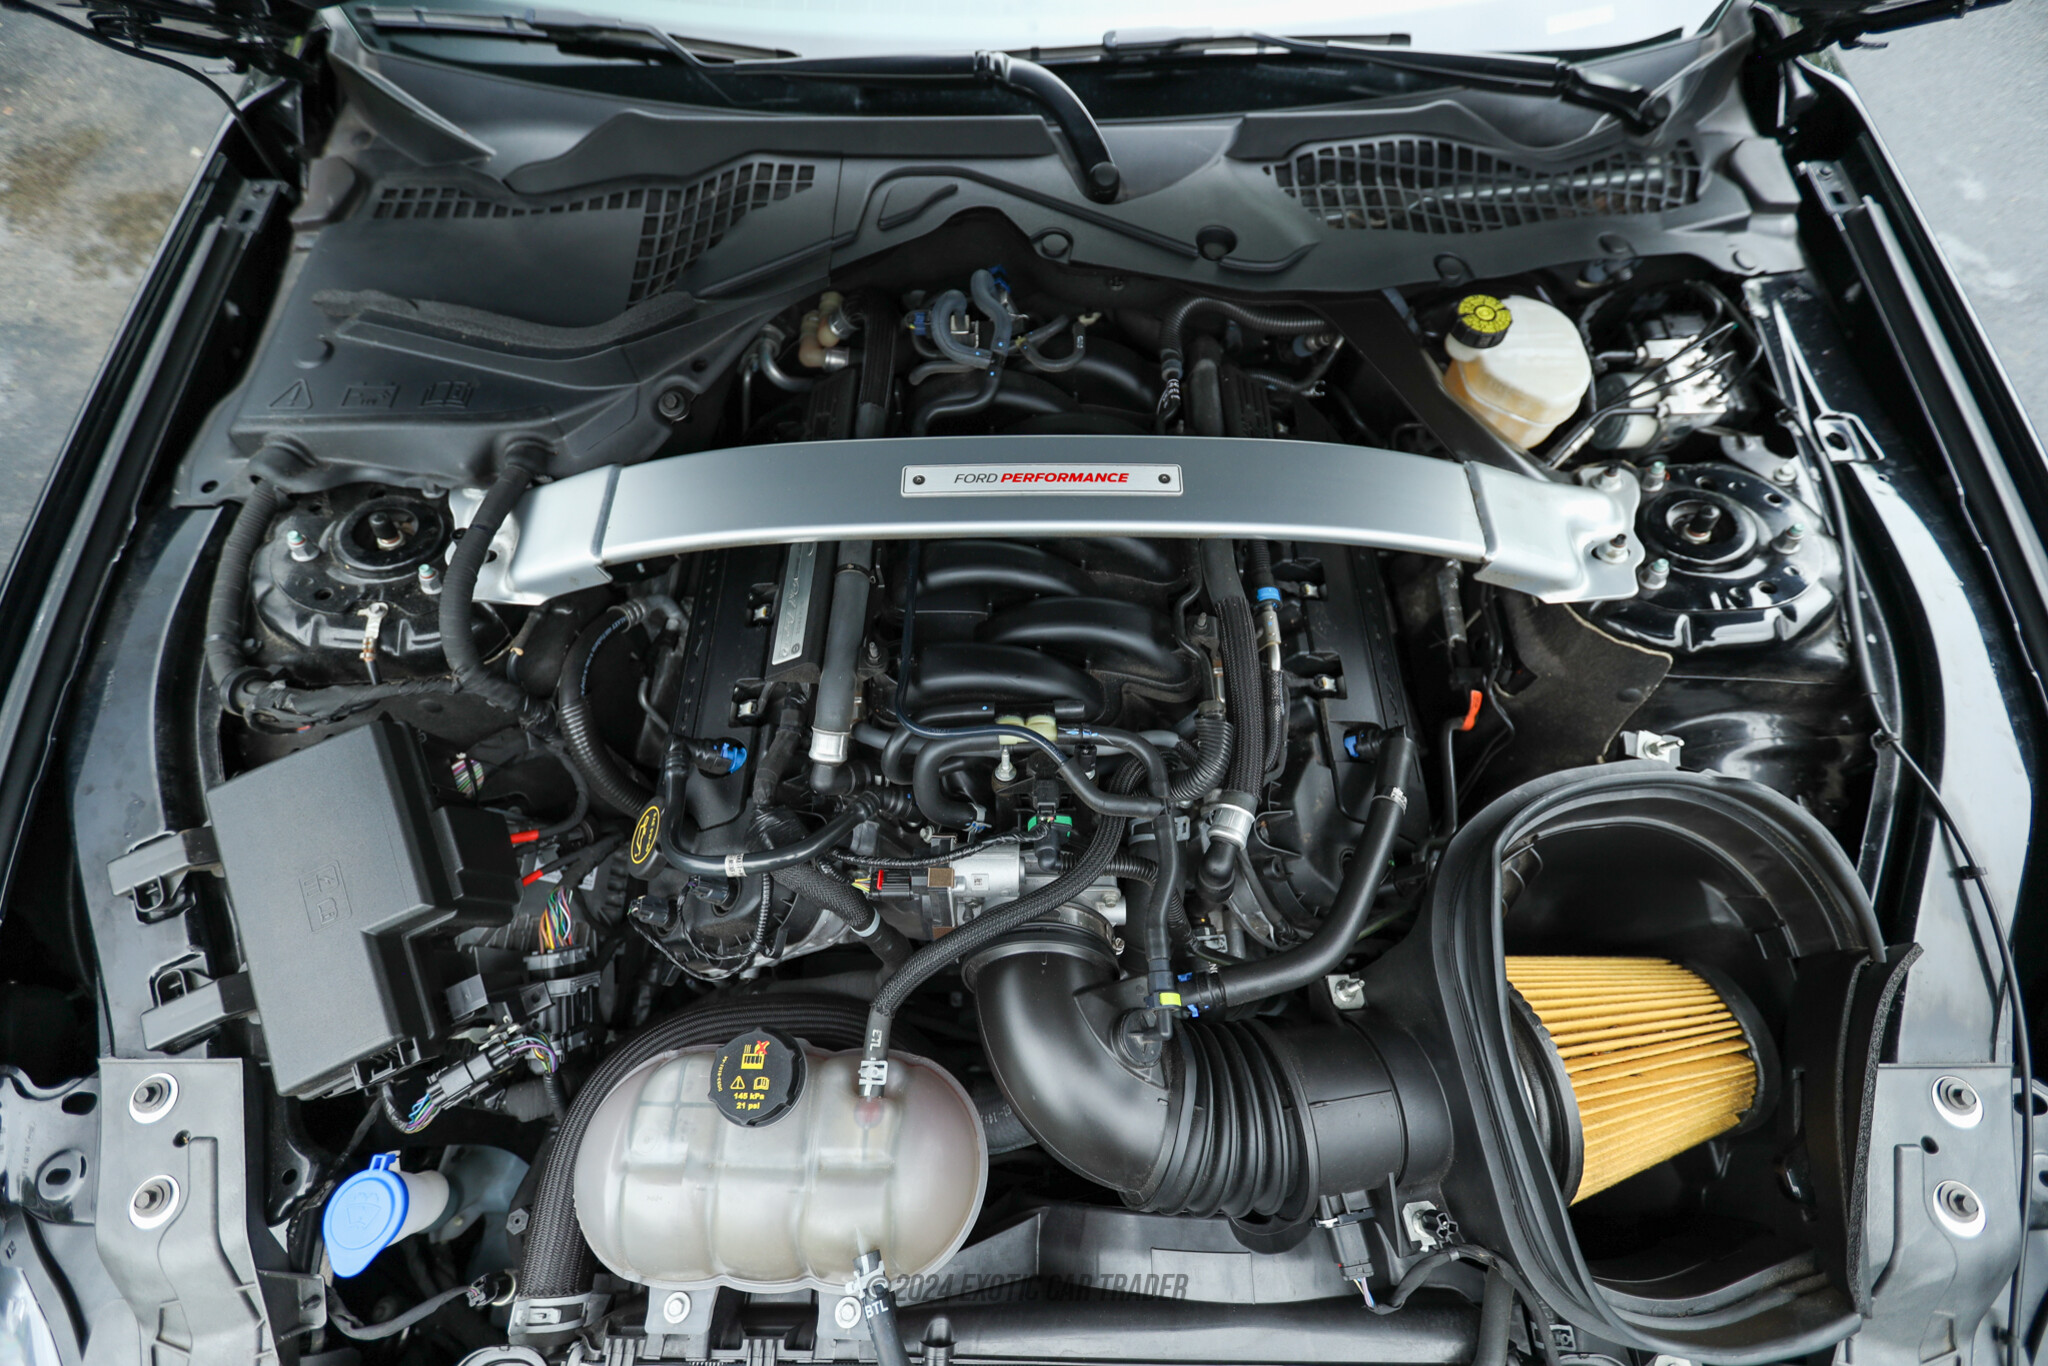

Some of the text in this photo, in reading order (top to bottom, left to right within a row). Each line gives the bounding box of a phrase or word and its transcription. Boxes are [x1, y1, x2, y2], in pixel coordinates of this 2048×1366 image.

[954, 472, 1129, 484] FORD PERFORMANCE
[734, 1092, 765, 1100] 145 kPa
[736, 1101, 760, 1111] 21 psi
[865, 1300, 889, 1319] BTL
